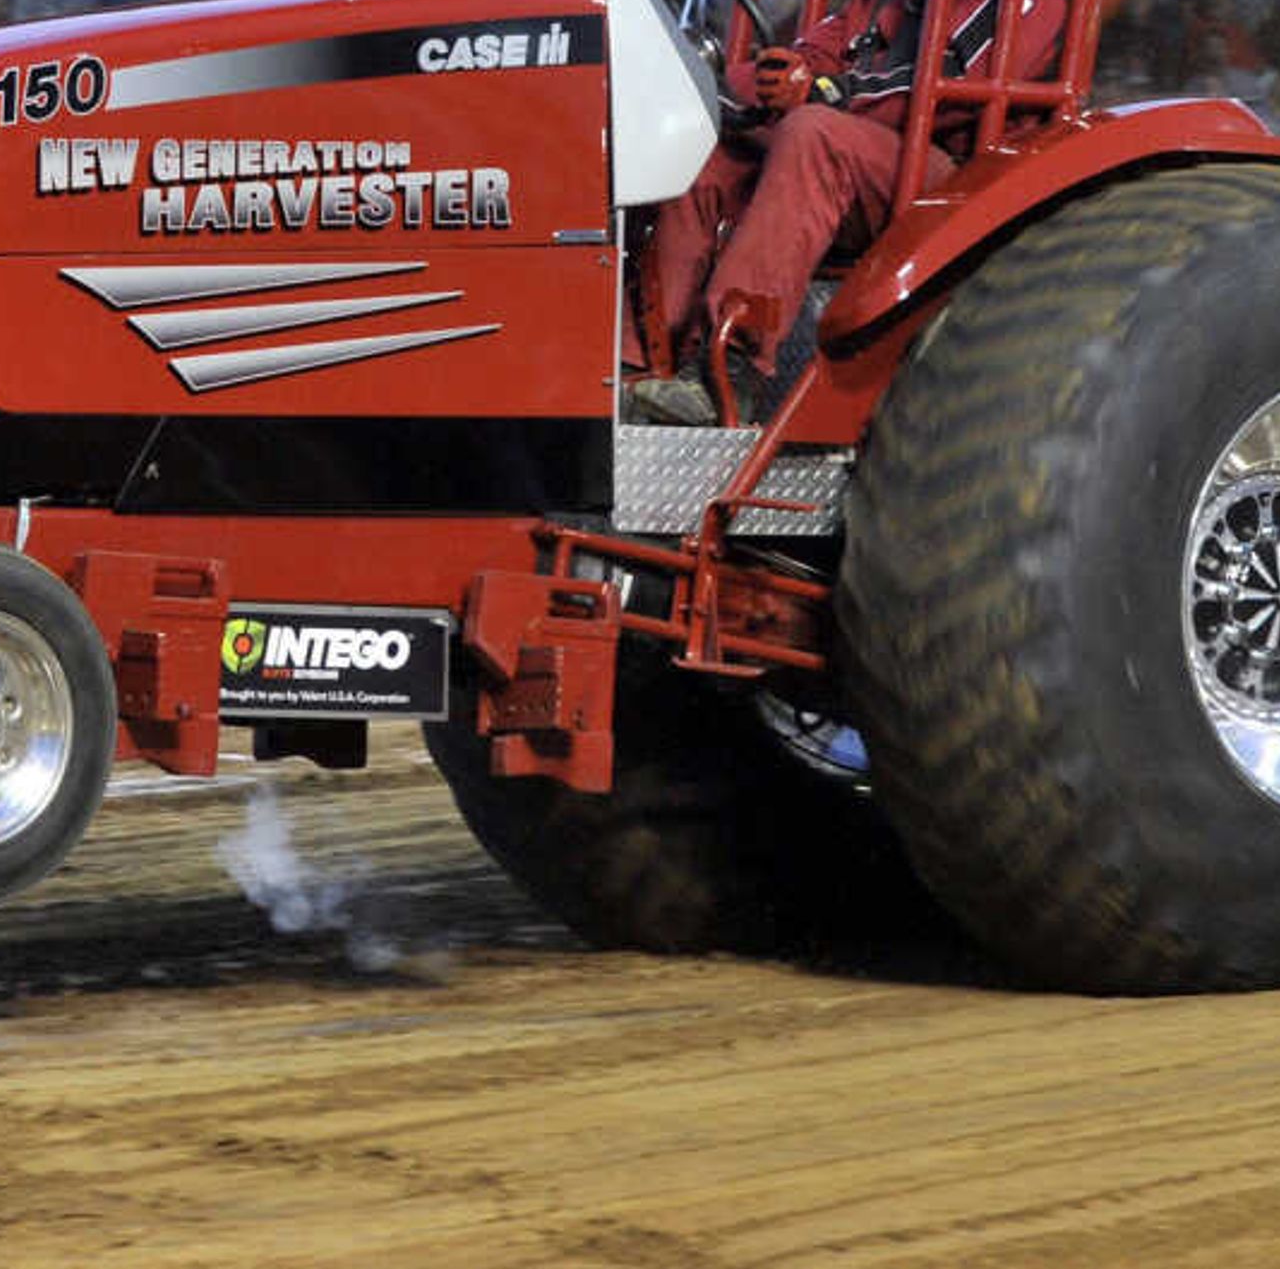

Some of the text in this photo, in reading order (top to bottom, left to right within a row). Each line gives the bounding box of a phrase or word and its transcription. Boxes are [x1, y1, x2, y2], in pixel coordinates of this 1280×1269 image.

[417, 33, 530, 73] CASE
[37, 137, 412, 193] NEW GENERATION
[141, 167, 513, 234] HARVESTER
[262, 626, 411, 673] INTEGO
